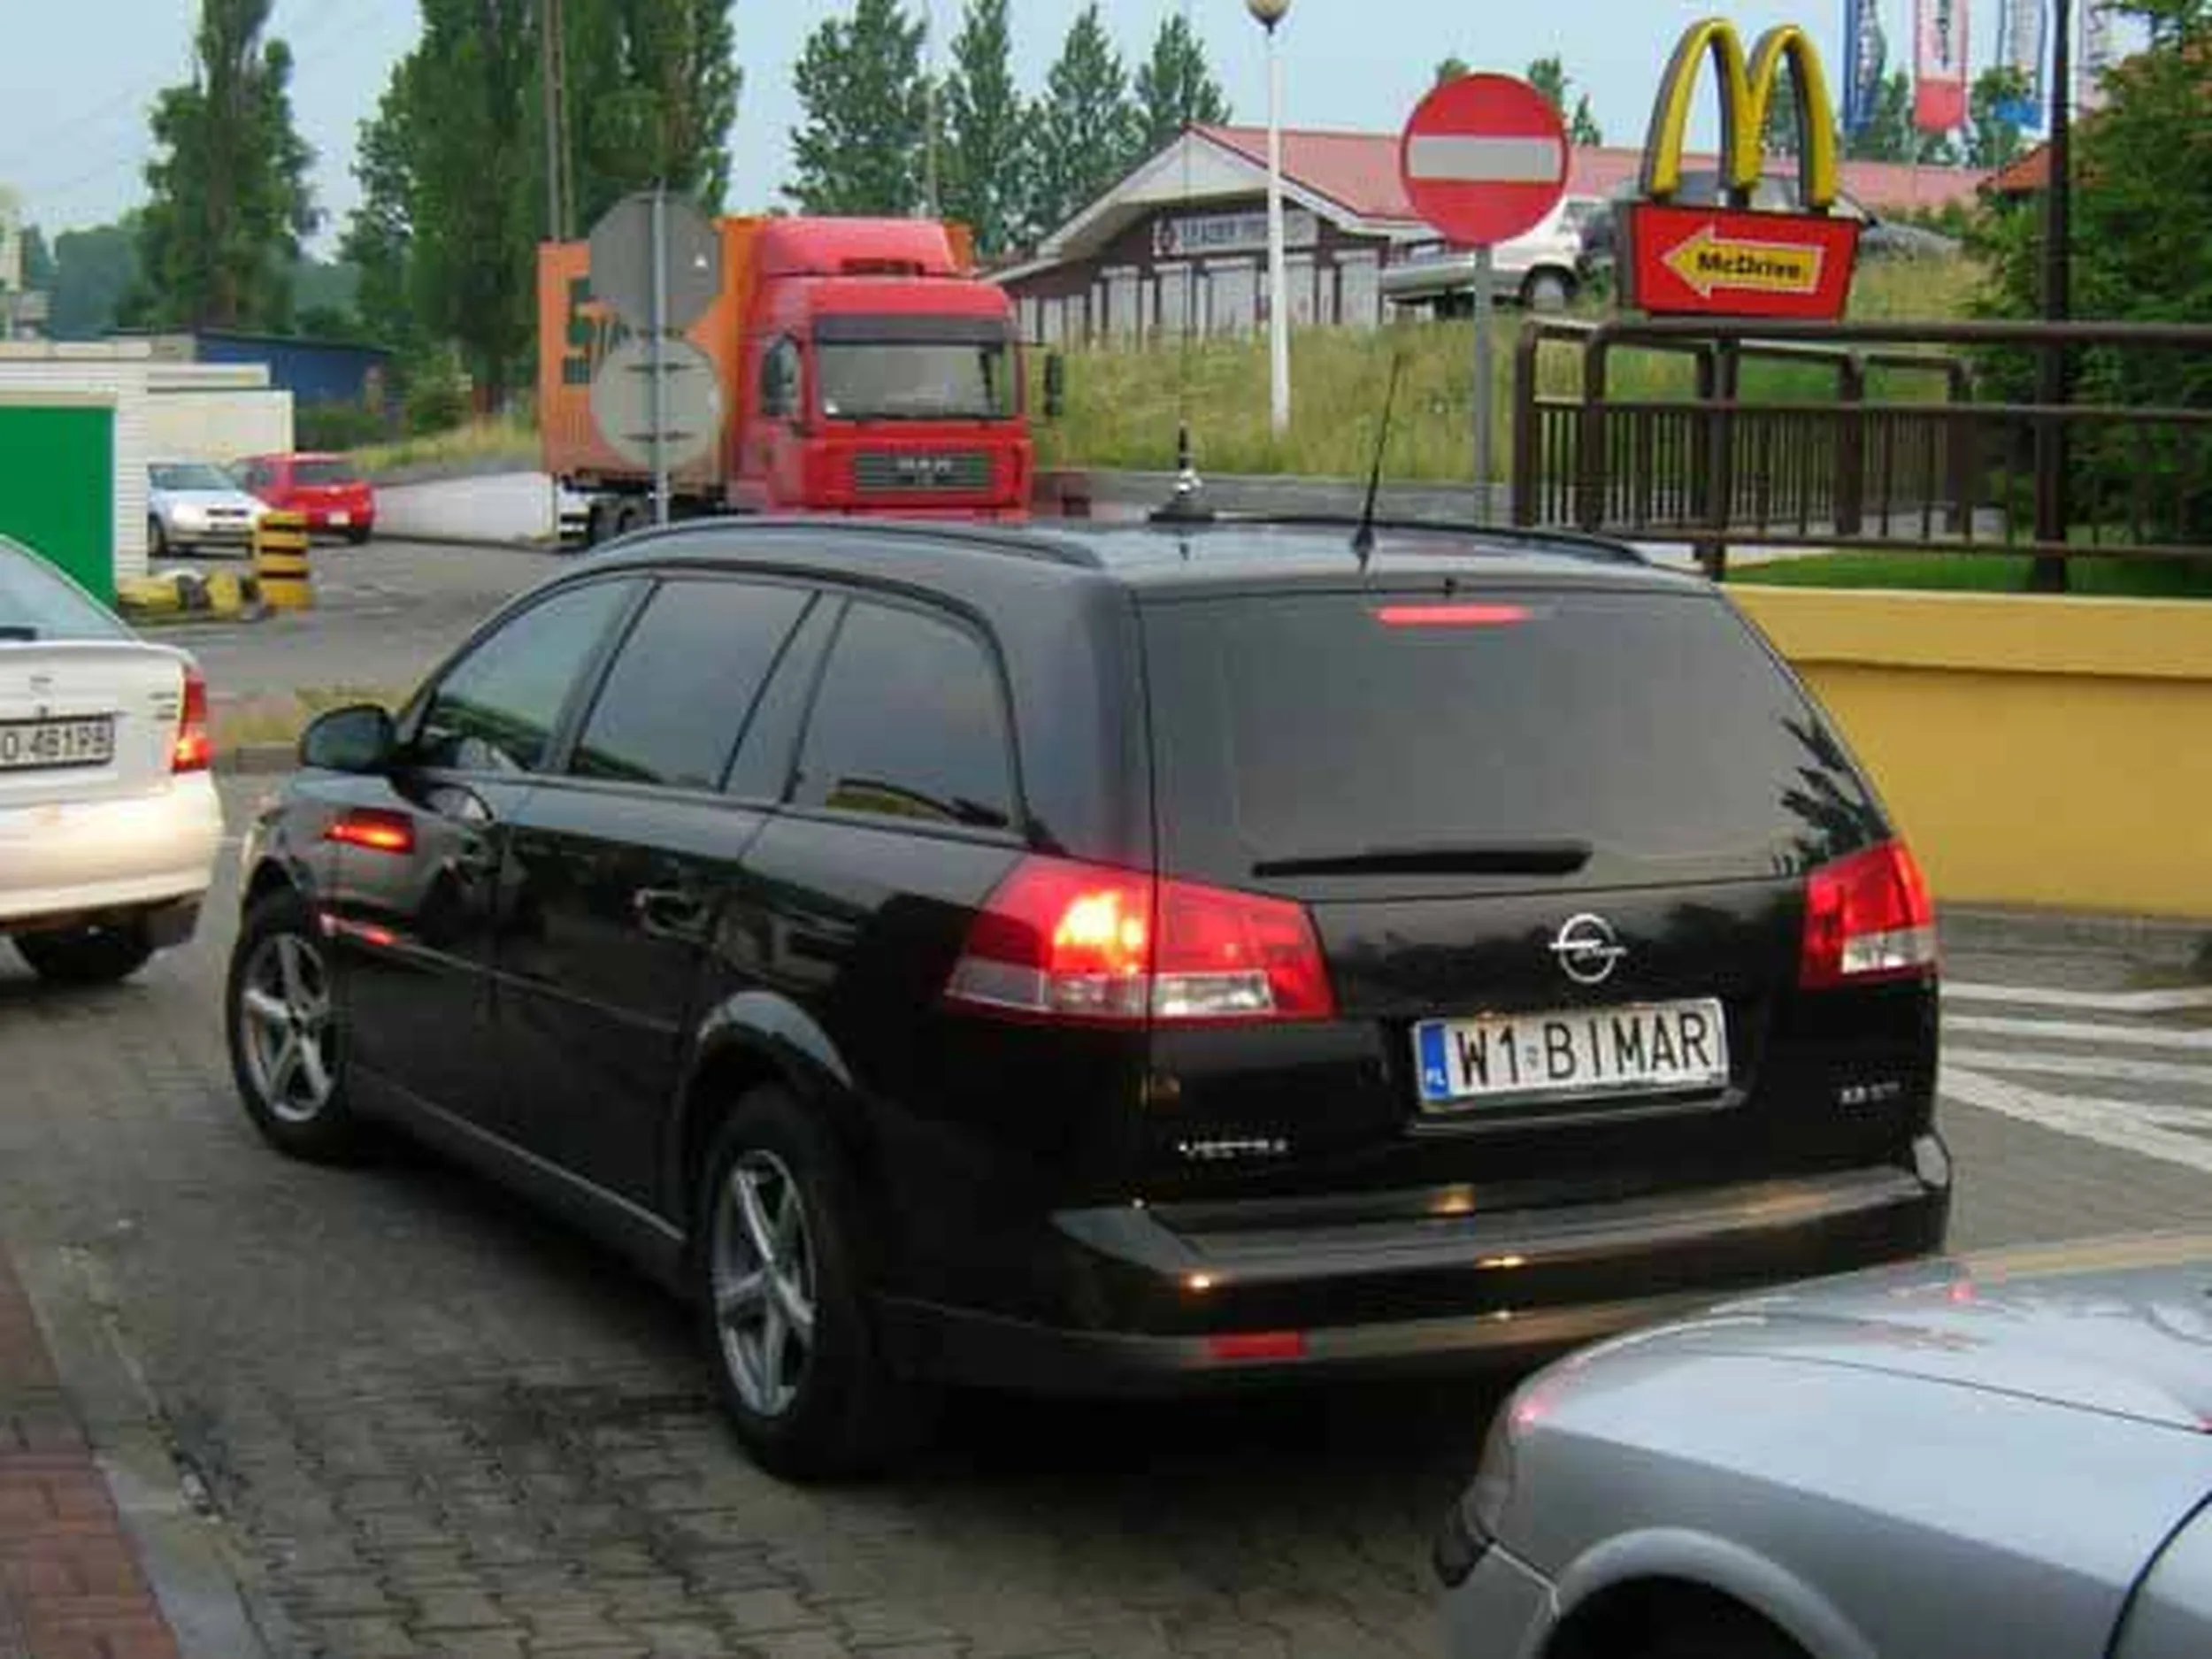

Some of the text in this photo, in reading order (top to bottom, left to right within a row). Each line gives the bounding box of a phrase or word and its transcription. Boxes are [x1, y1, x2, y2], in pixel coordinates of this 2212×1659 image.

[1697, 250, 1801, 279] McDrive
[1455, 1011, 1712, 1087] W1 BIMAR
